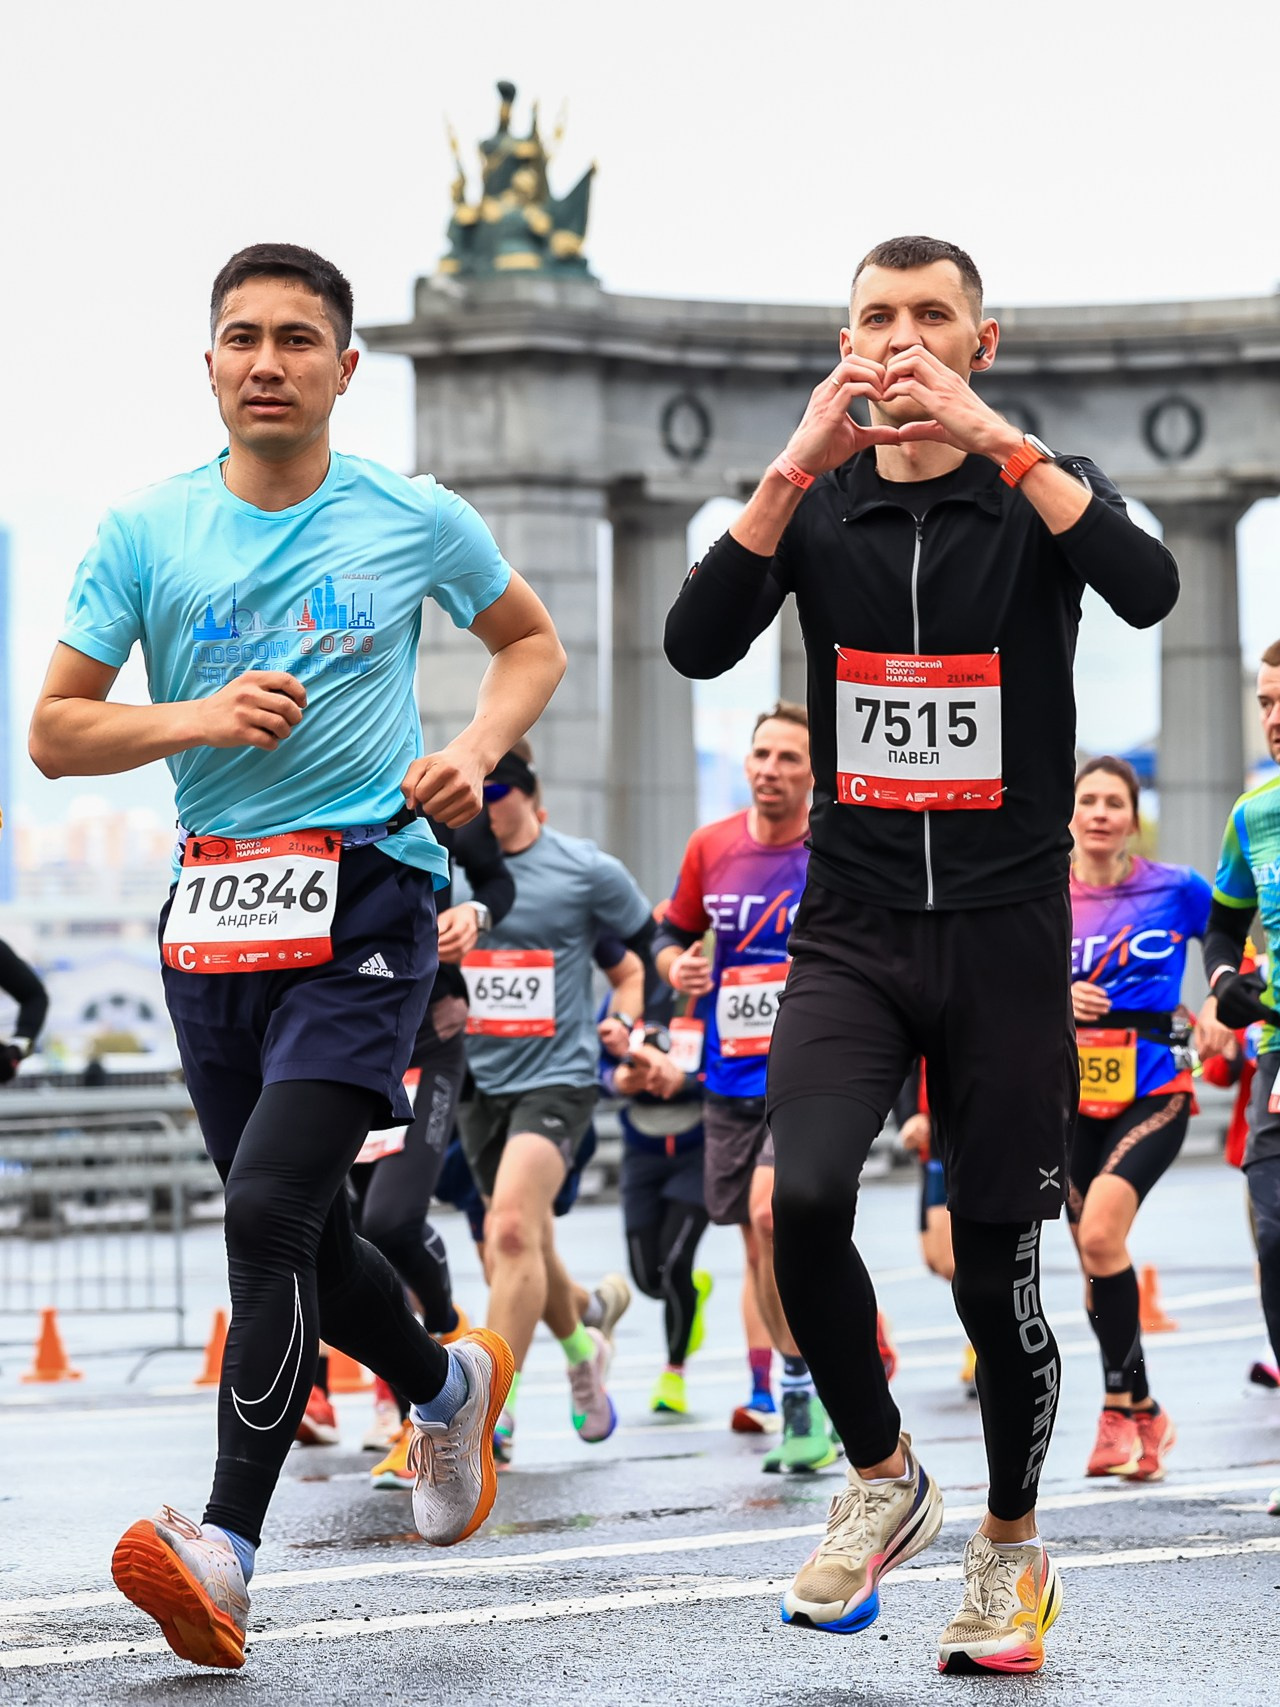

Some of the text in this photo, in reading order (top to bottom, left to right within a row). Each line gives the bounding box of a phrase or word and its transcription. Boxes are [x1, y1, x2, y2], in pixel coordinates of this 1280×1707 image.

[787, 467, 808, 486] 7515
[192, 640, 289, 665] MOSCOW
[885, 659, 943, 669] МОСКОВСКИЙ
[886, 675, 927, 683] МАРАФОН
[855, 696, 978, 748] 7515
[888, 750, 940, 765] ПАВЕЛ
[235, 841, 255, 851] ПОЛУ
[236, 847, 271, 858] МАРАФОН
[186, 868, 328, 914] 10346
[216, 911, 278, 928] АНДРЕЙ
[358, 966, 394, 979] adidas
[475, 976, 540, 1002] 6549
